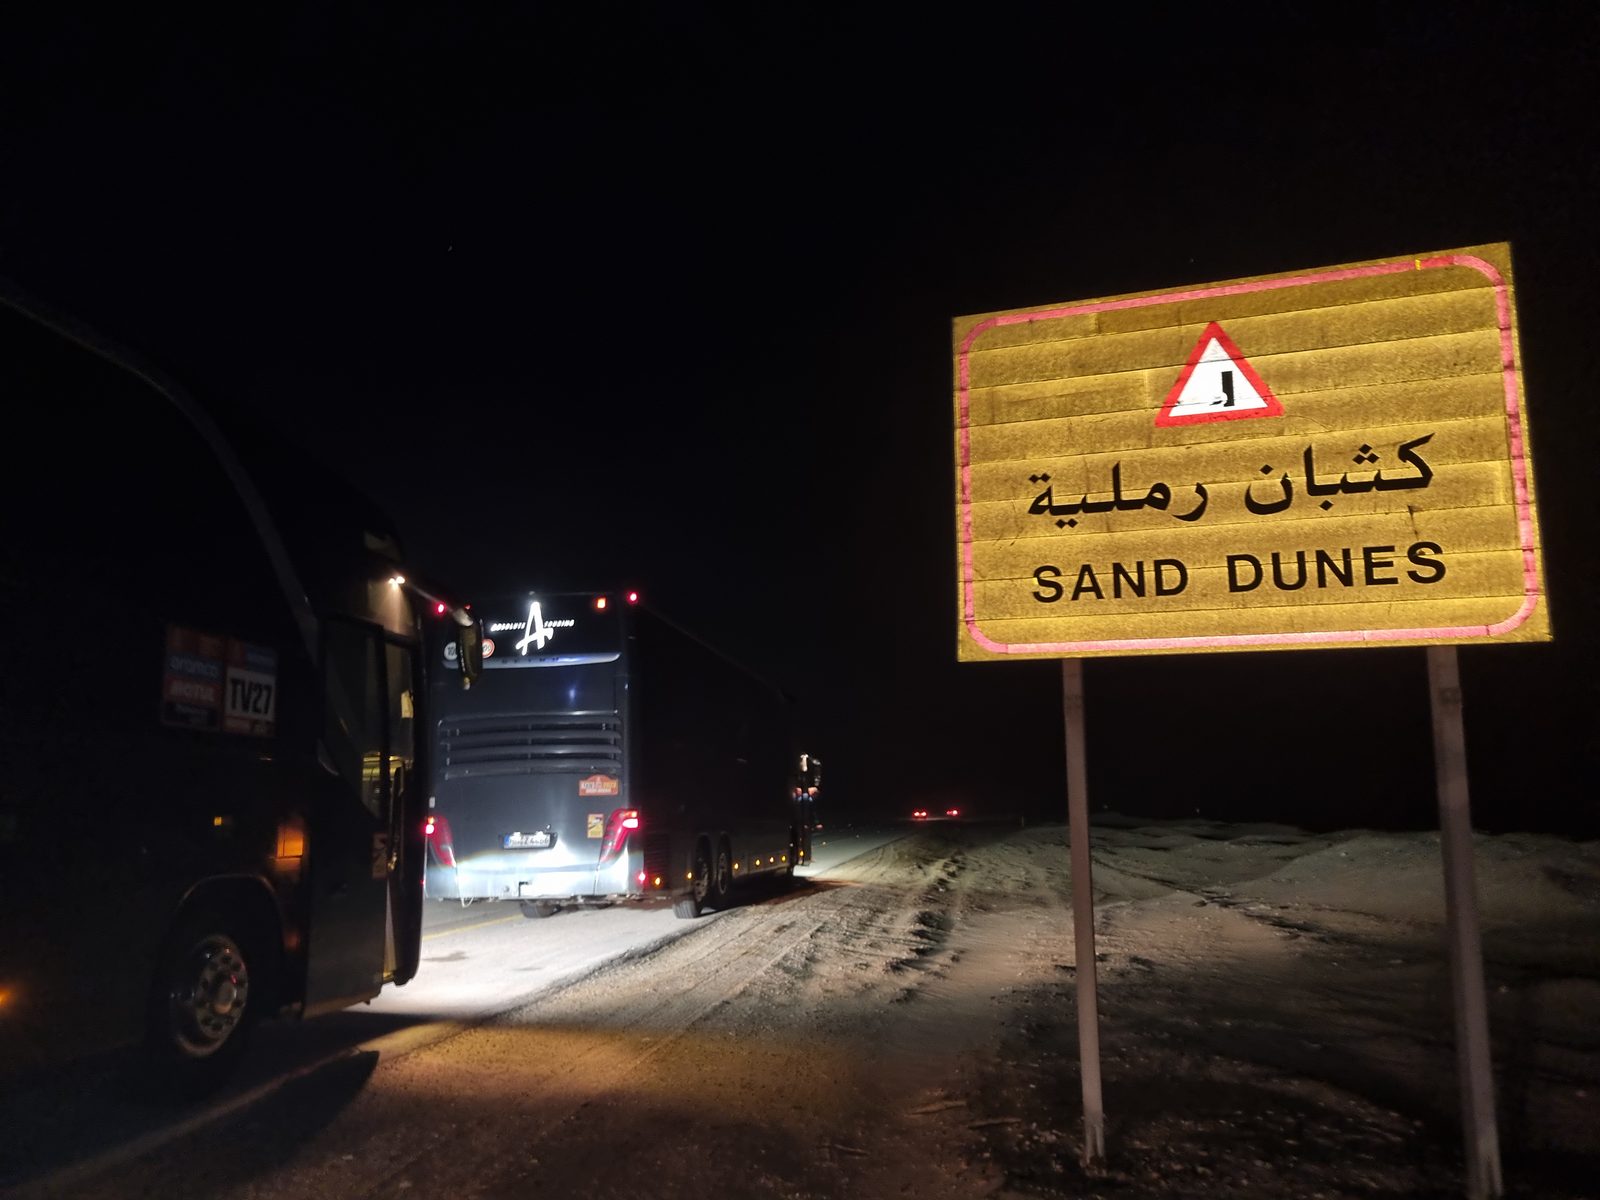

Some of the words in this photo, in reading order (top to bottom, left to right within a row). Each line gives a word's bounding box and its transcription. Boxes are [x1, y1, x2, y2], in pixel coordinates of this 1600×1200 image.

[1028, 462, 1208, 529] رملية
[1244, 434, 1434, 516] كثبان
[1033, 558, 1188, 603] SAND
[1227, 542, 1446, 592] DUNES
[231, 679, 272, 714] TV27
